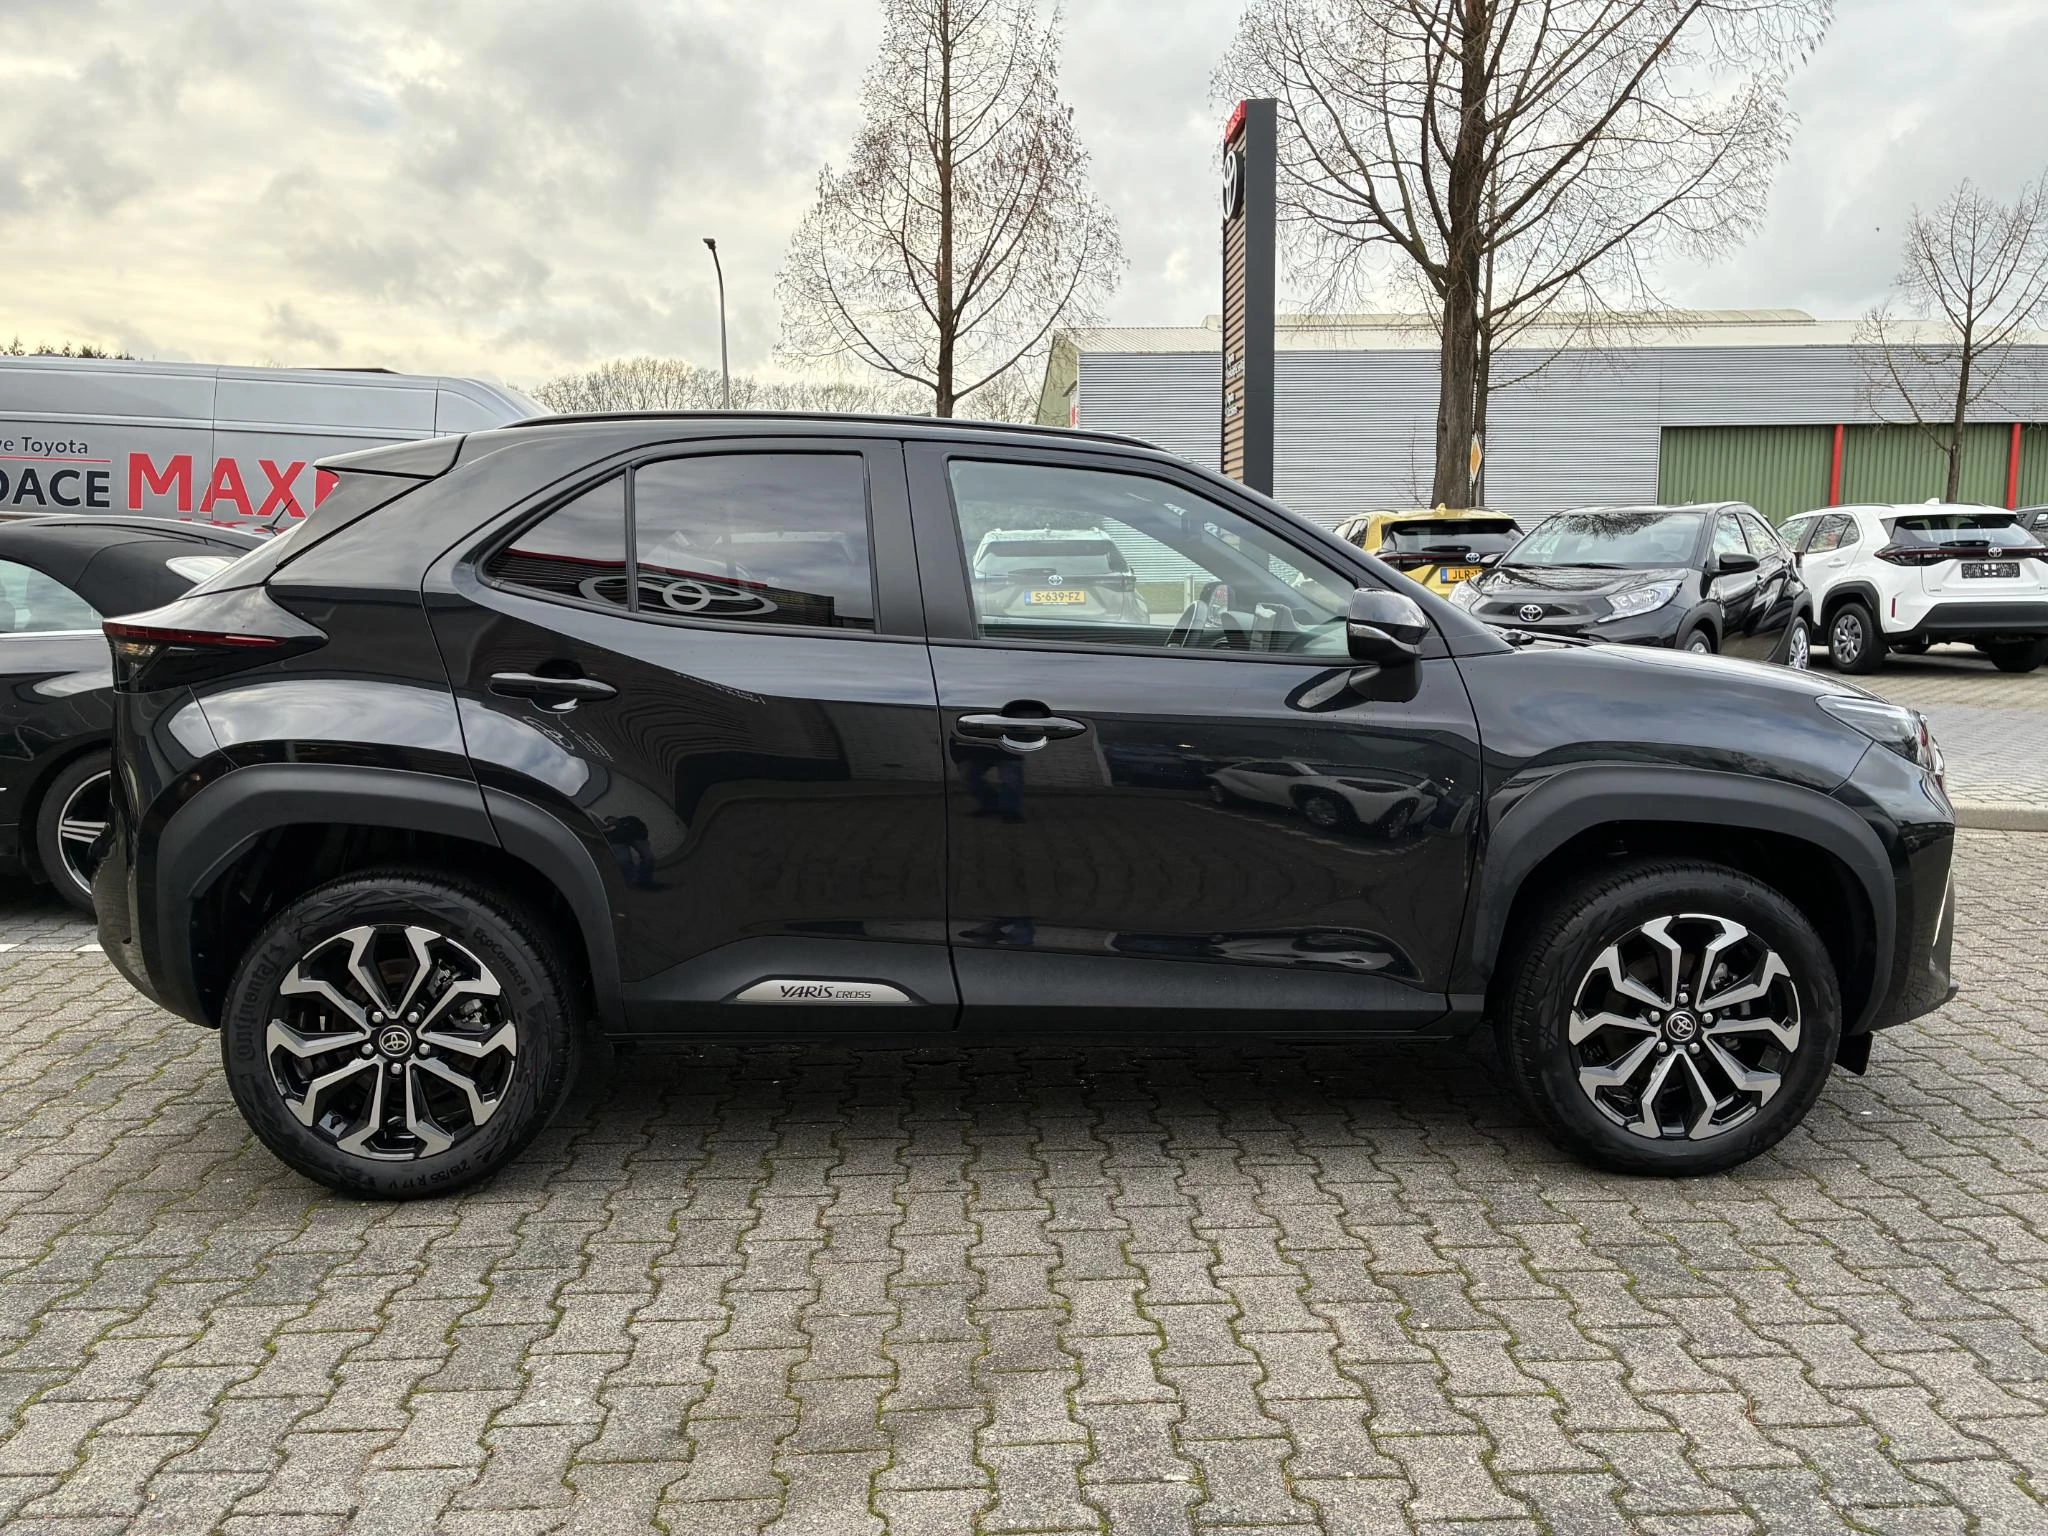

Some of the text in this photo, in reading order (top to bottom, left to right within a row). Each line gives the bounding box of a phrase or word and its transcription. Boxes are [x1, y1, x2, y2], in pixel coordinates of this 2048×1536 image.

[21, 437, 88, 456] Toyota
[0, 468, 111, 507] ACE
[1035, 591, 1080, 602] S-639-FZ
[835, 991, 871, 999] CROSS
[234, 952, 280, 1061] Continental
[430, 1159, 471, 1184] 215/55
